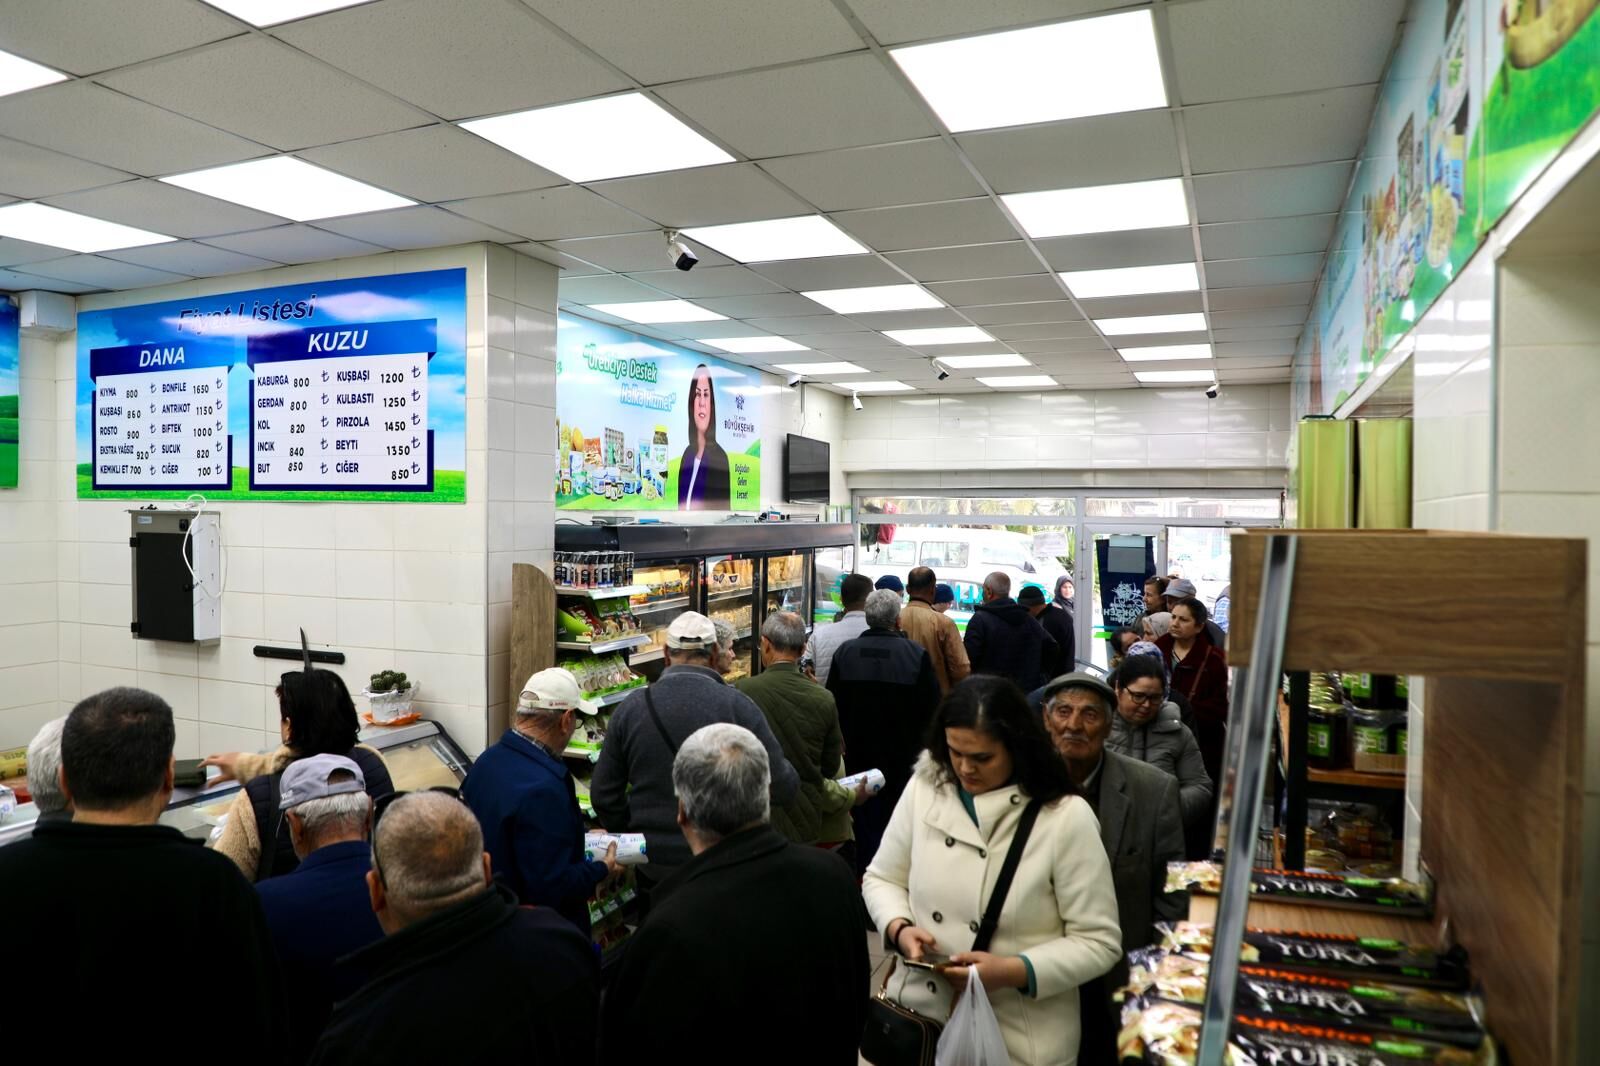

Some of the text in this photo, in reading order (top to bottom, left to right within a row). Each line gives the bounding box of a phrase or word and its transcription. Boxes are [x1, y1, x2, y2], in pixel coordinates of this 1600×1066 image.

[178, 295, 316, 334] Fiyat Listesi
[308, 330, 368, 353] KUZU
[139, 347, 185, 368] DANA
[337, 370, 369, 382] KUŞBAŞI
[381, 373, 403, 383] 1200
[628, 358, 658, 383] Destek
[258, 375, 289, 386] KABURGA
[294, 378, 309, 388] 800
[100, 388, 116, 397] KIYMA
[126, 390, 138, 398] 800
[193, 385, 209, 394] 1650
[258, 398, 284, 408] GERDAN
[290, 401, 307, 411] 800
[384, 397, 406, 407] 1250
[100, 407, 122, 416] KUŞBAŞI
[127, 410, 141, 419] 860
[197, 406, 213, 415] 1150
[258, 420, 270, 429] KOL
[290, 424, 305, 433] 820
[385, 421, 405, 431] 1450
[724, 419, 755, 434] BÜYÜKŞEHİR
[100, 426, 117, 435] ROSTO
[127, 431, 139, 439] 900
[194, 428, 212, 437] 1000
[100, 446, 117, 454] EKSTRA
[137, 451, 149, 460] 920
[162, 444, 180, 453] SUCUK
[197, 450, 209, 458] 820
[290, 447, 304, 456] 840
[387, 446, 410, 455] 1350
[122, 465, 128, 474] ET
[130, 466, 141, 474] 700
[198, 467, 211, 477] 700
[258, 463, 270, 473] BUT
[288, 462, 303, 471] 850
[392, 470, 409, 480] 850
